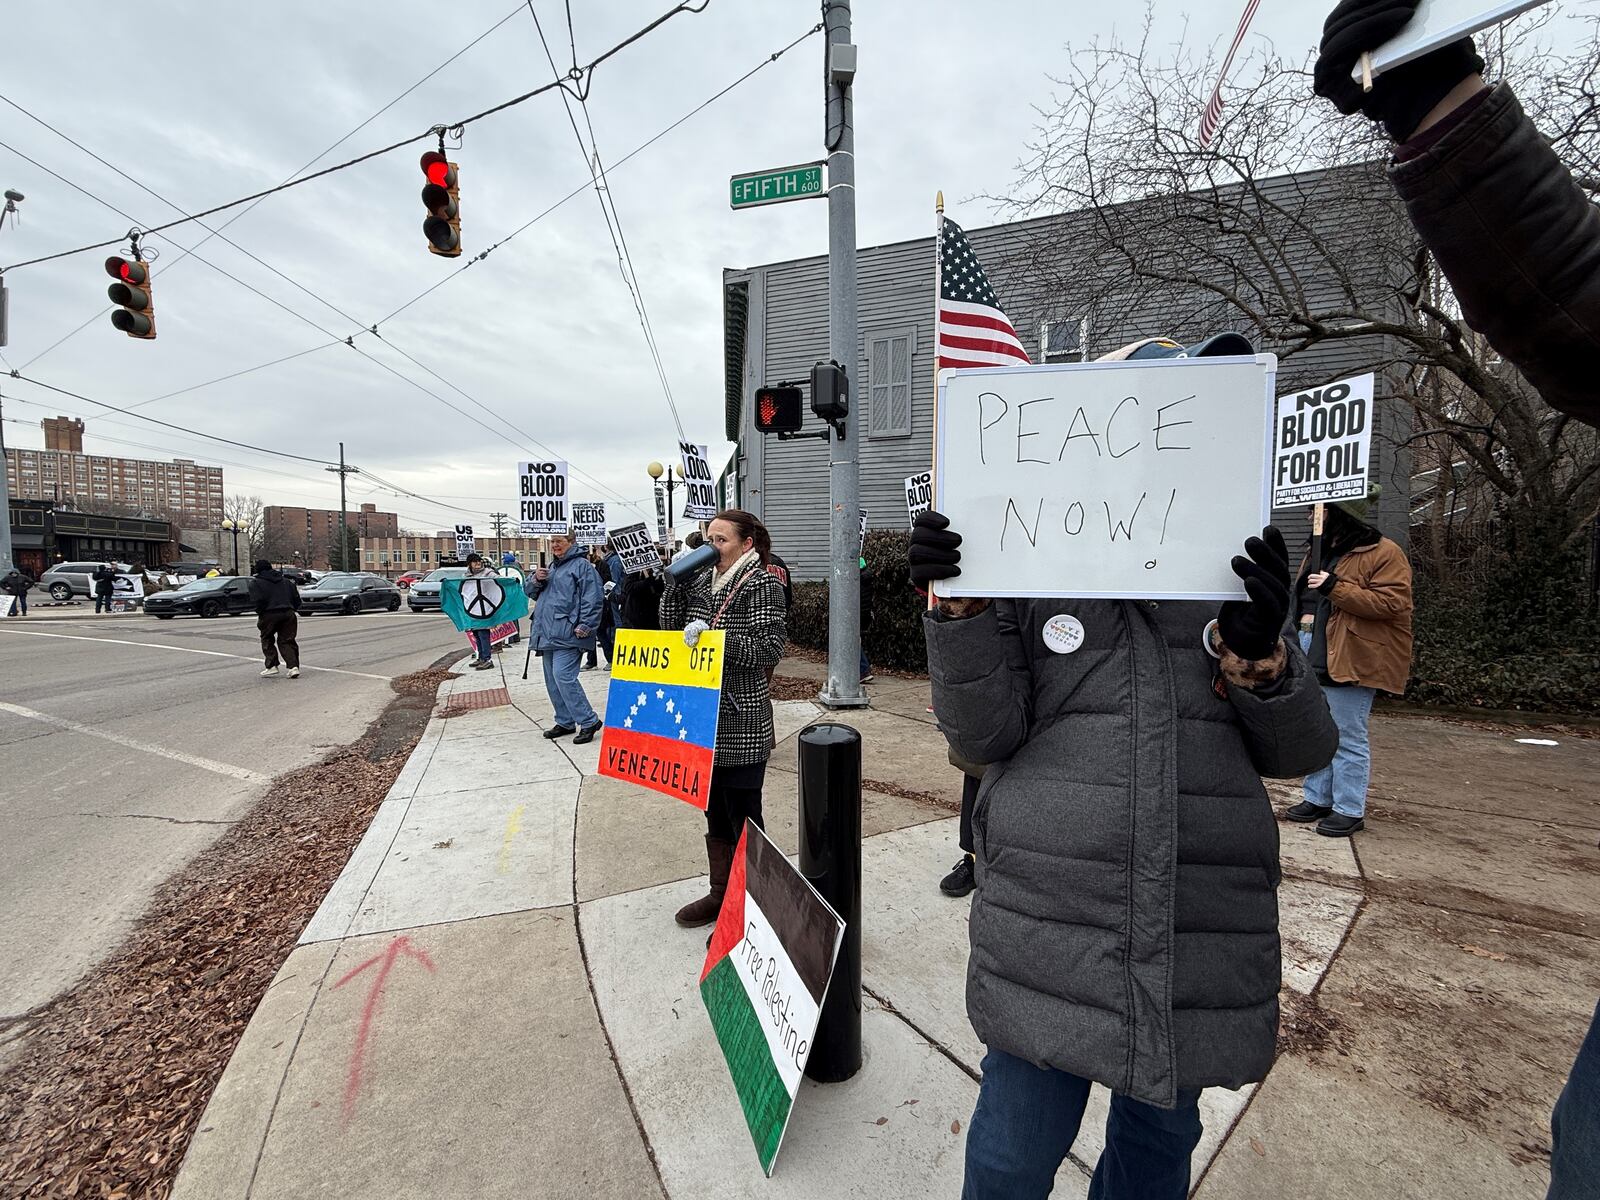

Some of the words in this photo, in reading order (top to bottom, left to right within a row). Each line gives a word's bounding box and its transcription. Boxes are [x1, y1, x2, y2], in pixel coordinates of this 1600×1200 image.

[735, 185, 741, 198] E
[743, 174, 797, 200] FIFTH
[805, 170, 816, 181] ST
[801, 181, 819, 192] 600
[1296, 383, 1351, 412] NO
[978, 392, 1196, 464] PEACE
[1281, 398, 1366, 450] BLOOD
[680, 441, 699, 456] NO
[528, 463, 557, 474] NO
[682, 455, 711, 481] LOOD
[1277, 449, 1320, 487] FOR
[1325, 441, 1365, 480] OIL
[521, 475, 565, 497] BLOOD
[911, 473, 931, 487] NO
[700, 484, 716, 507] OIL
[908, 483, 932, 507] BLOO
[1276, 487, 1362, 505] PSLWEB.ORG
[521, 500, 543, 521] FOR
[546, 500, 566, 521] OIL
[573, 509, 605, 523] NEEDS
[455, 525, 473, 535] US
[1001, 488, 1175, 569] NOW!
[613, 535, 631, 552] NO
[629, 531, 652, 547] U.S.
[619, 546, 655, 559] WAR
[622, 551, 659, 568] VENEZUELA
[616, 644, 670, 670] HANDS
[690, 647, 715, 672] OFF
[608, 746, 699, 798] VENEZUELA
[741, 921, 763, 983] Free
[761, 957, 807, 1072] Palestine
